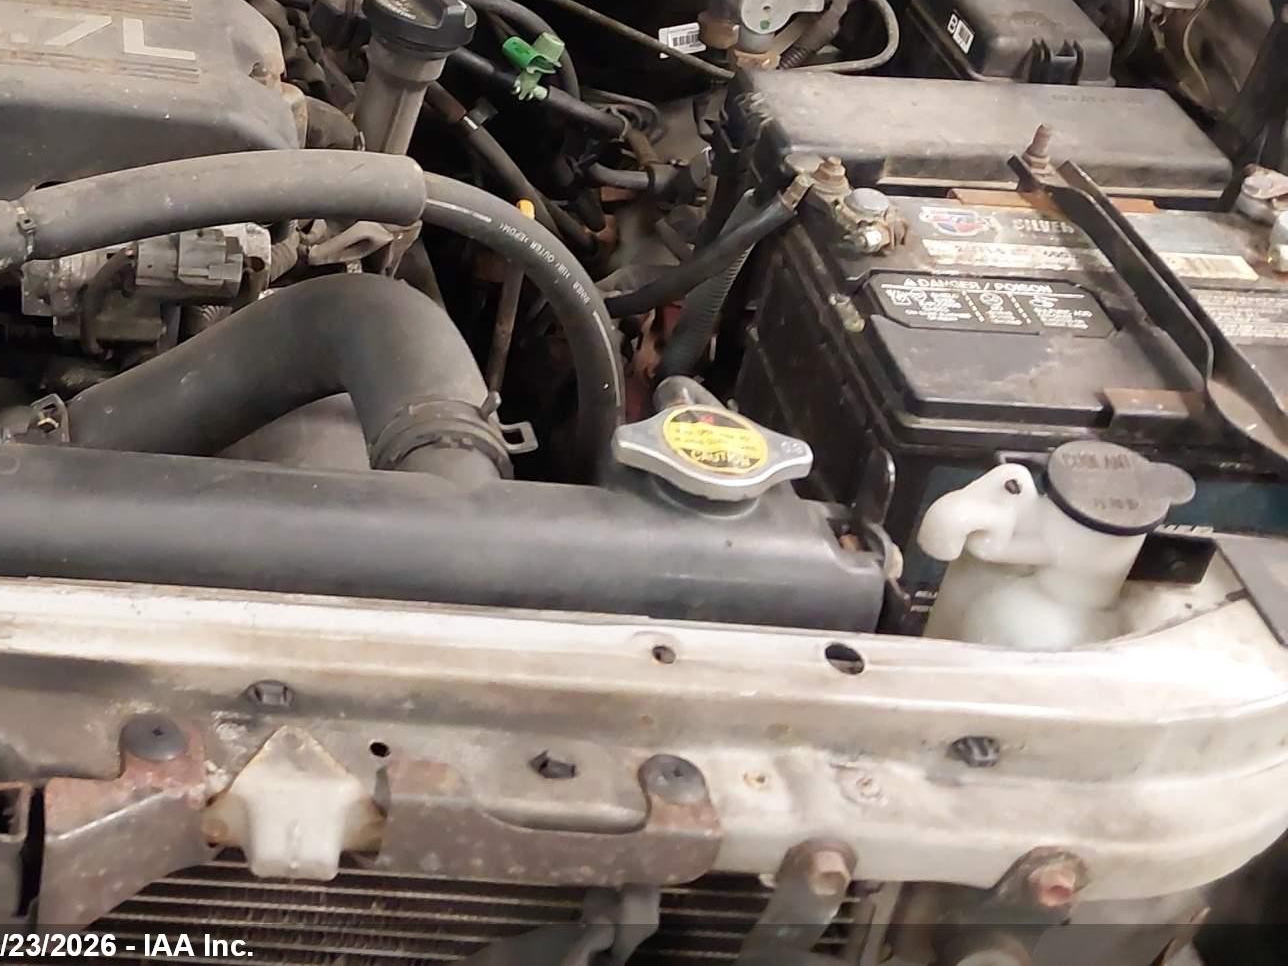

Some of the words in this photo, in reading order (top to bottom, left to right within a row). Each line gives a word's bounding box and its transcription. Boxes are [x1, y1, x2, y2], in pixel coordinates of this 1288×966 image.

[530, 240, 555, 263] OUTER
[917, 279, 981, 291] DANGER
[995, 282, 1053, 294] POISON
